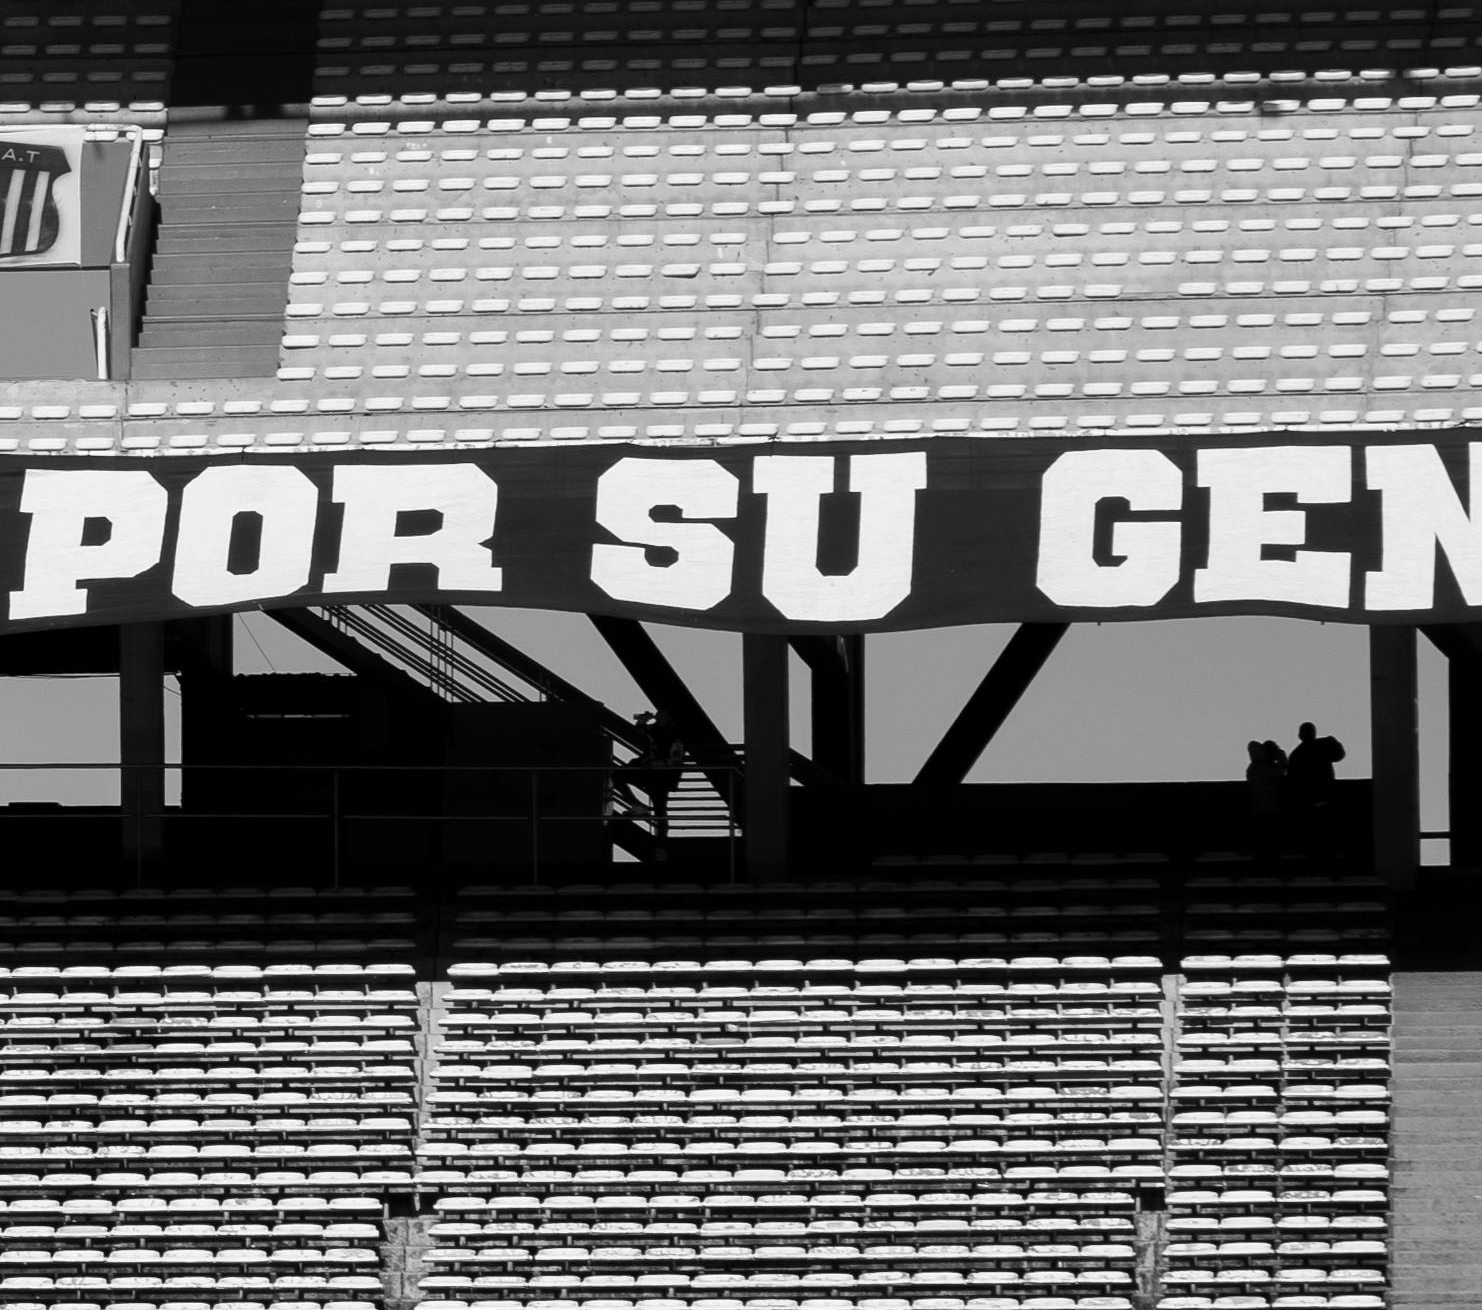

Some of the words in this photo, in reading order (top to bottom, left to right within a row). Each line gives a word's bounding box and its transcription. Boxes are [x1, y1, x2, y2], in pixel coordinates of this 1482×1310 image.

[8, 462, 503, 620] POR
[590, 451, 928, 622] SU
[1035, 441, 1482, 611] GEN
